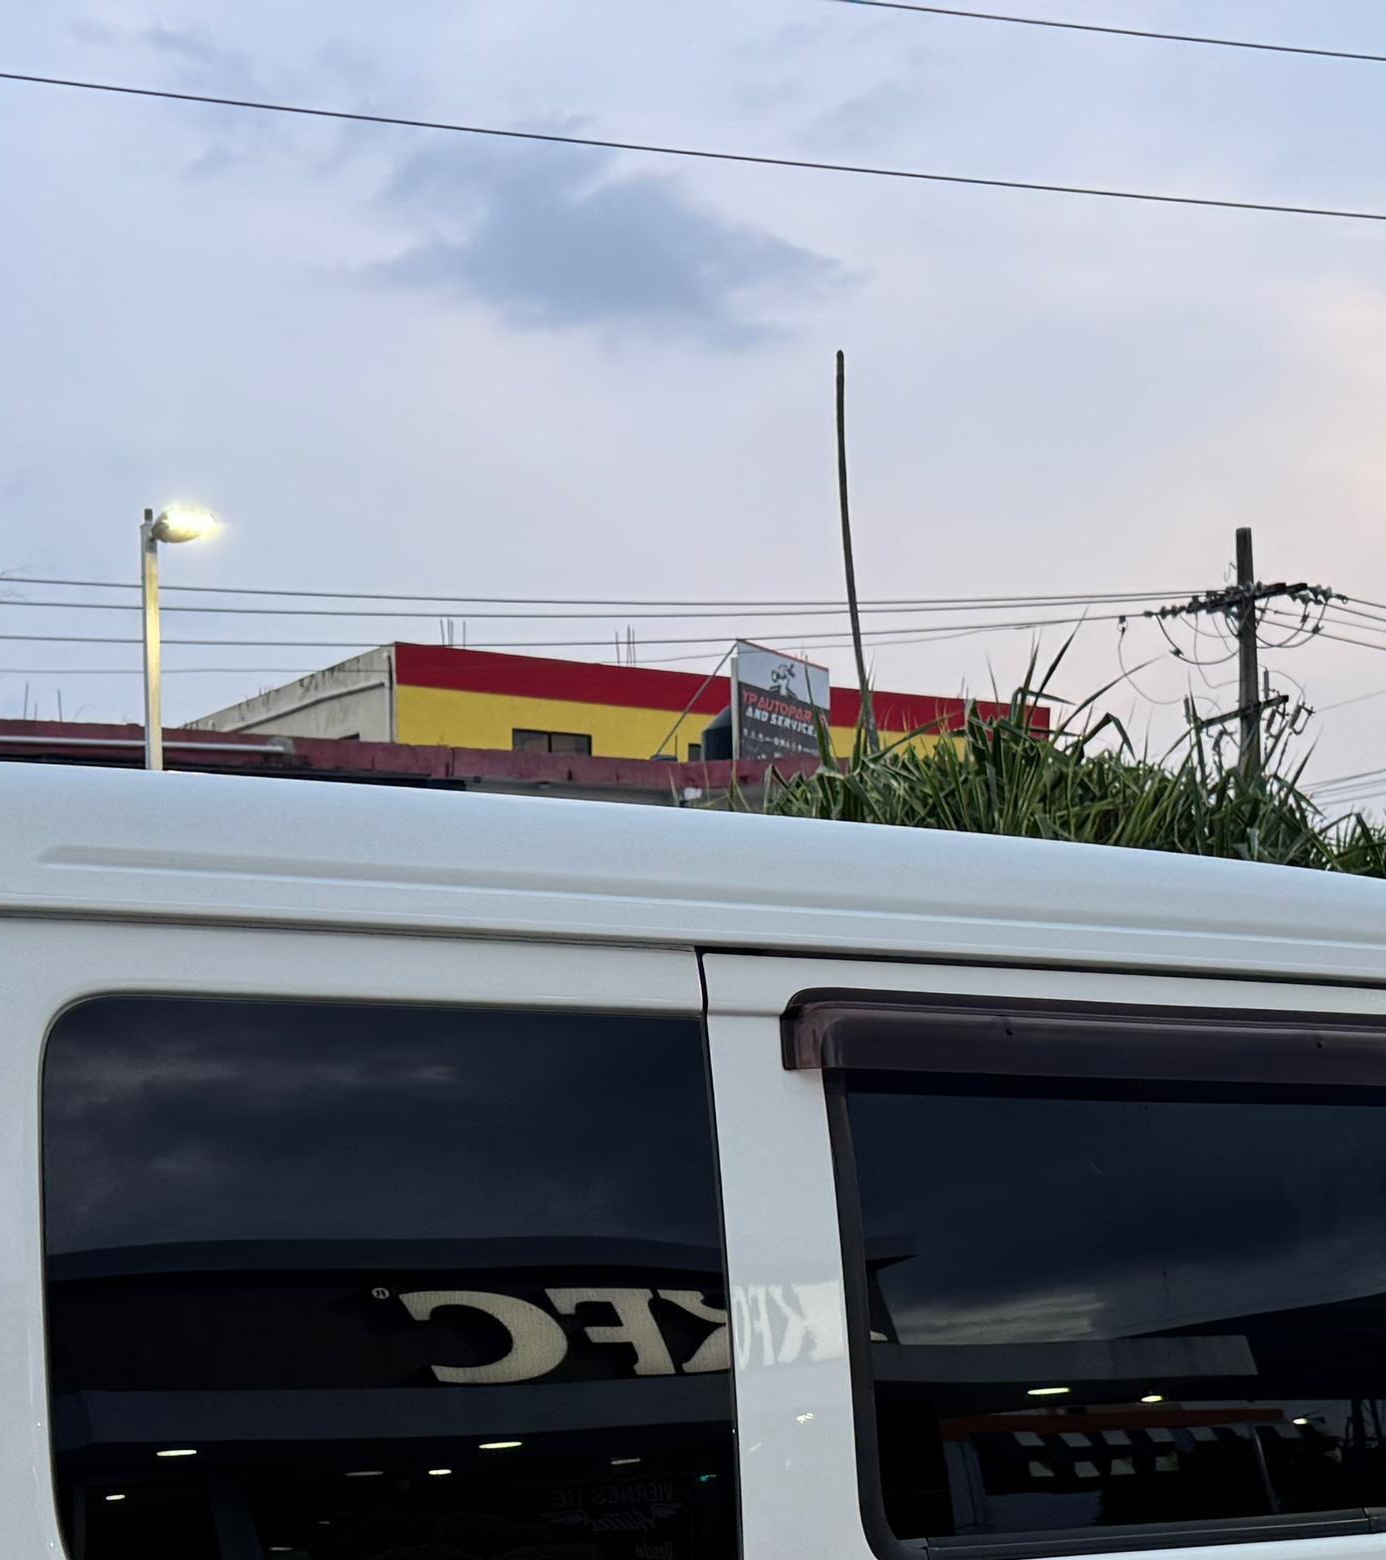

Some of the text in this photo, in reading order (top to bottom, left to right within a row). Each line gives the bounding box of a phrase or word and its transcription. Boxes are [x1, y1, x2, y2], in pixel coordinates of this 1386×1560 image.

[745, 706, 818, 738] AND SERVICE
[757, 696, 825, 727] AUTOPAR
